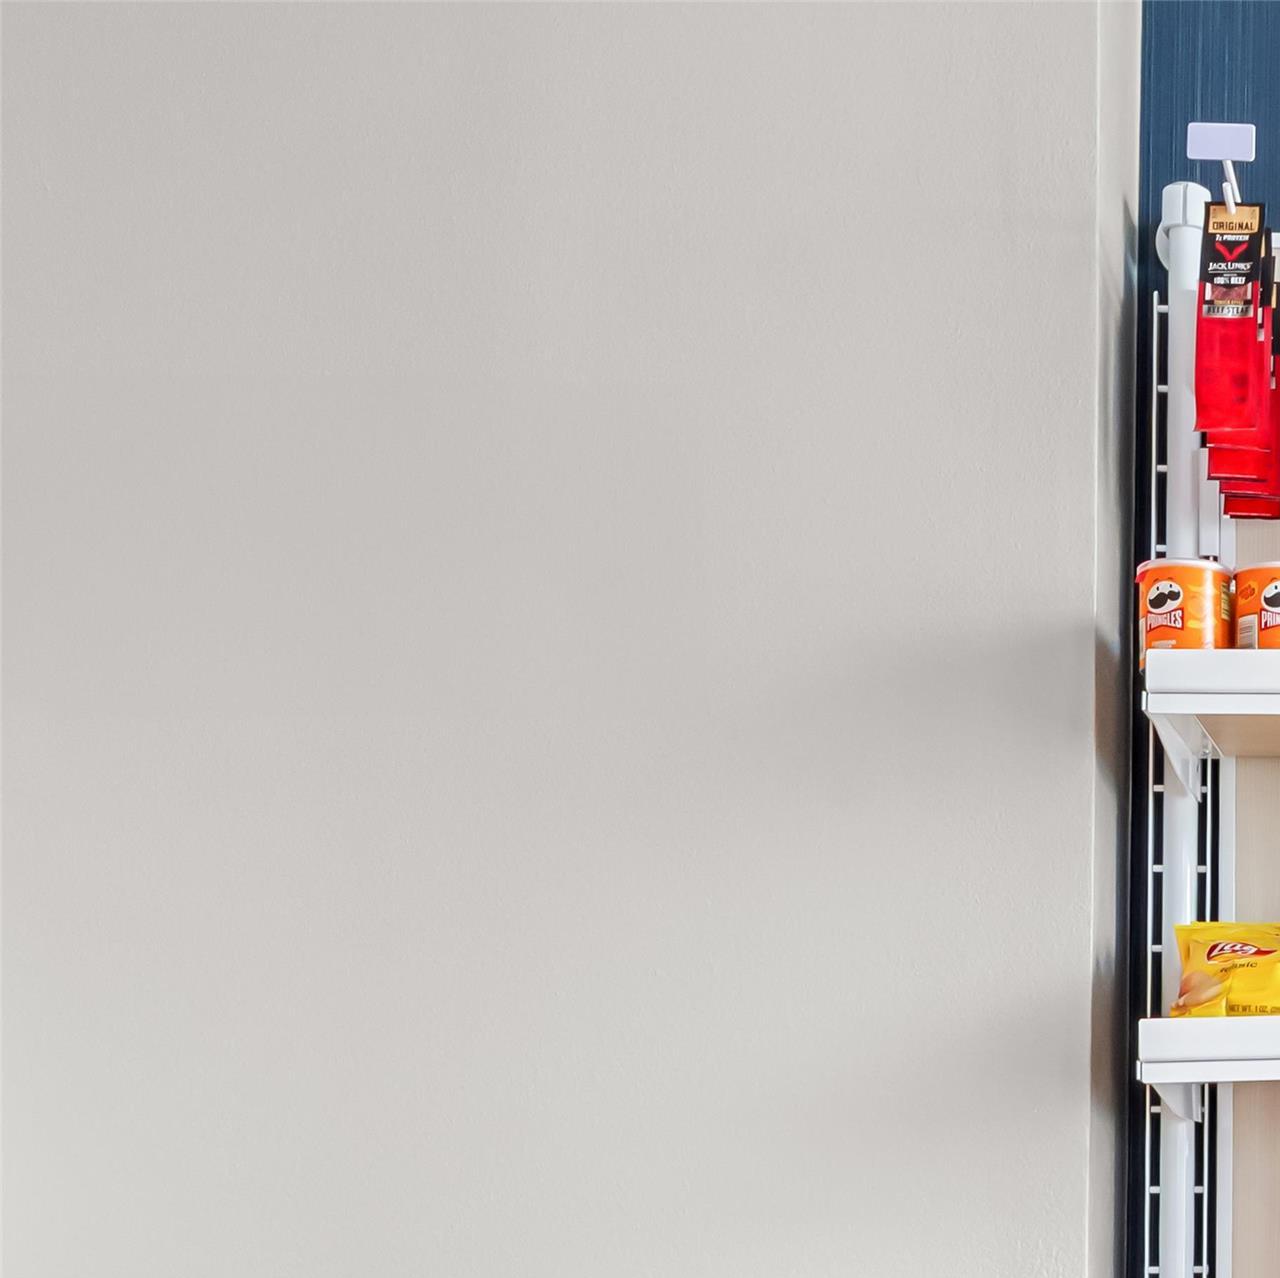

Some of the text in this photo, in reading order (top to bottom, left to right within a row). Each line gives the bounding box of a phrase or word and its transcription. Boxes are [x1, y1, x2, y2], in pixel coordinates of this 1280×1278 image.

[1212, 221, 1254, 231] ORIGINAL
[1208, 262, 1227, 271] JACK
[1147, 610, 1183, 631] PRINGLES
